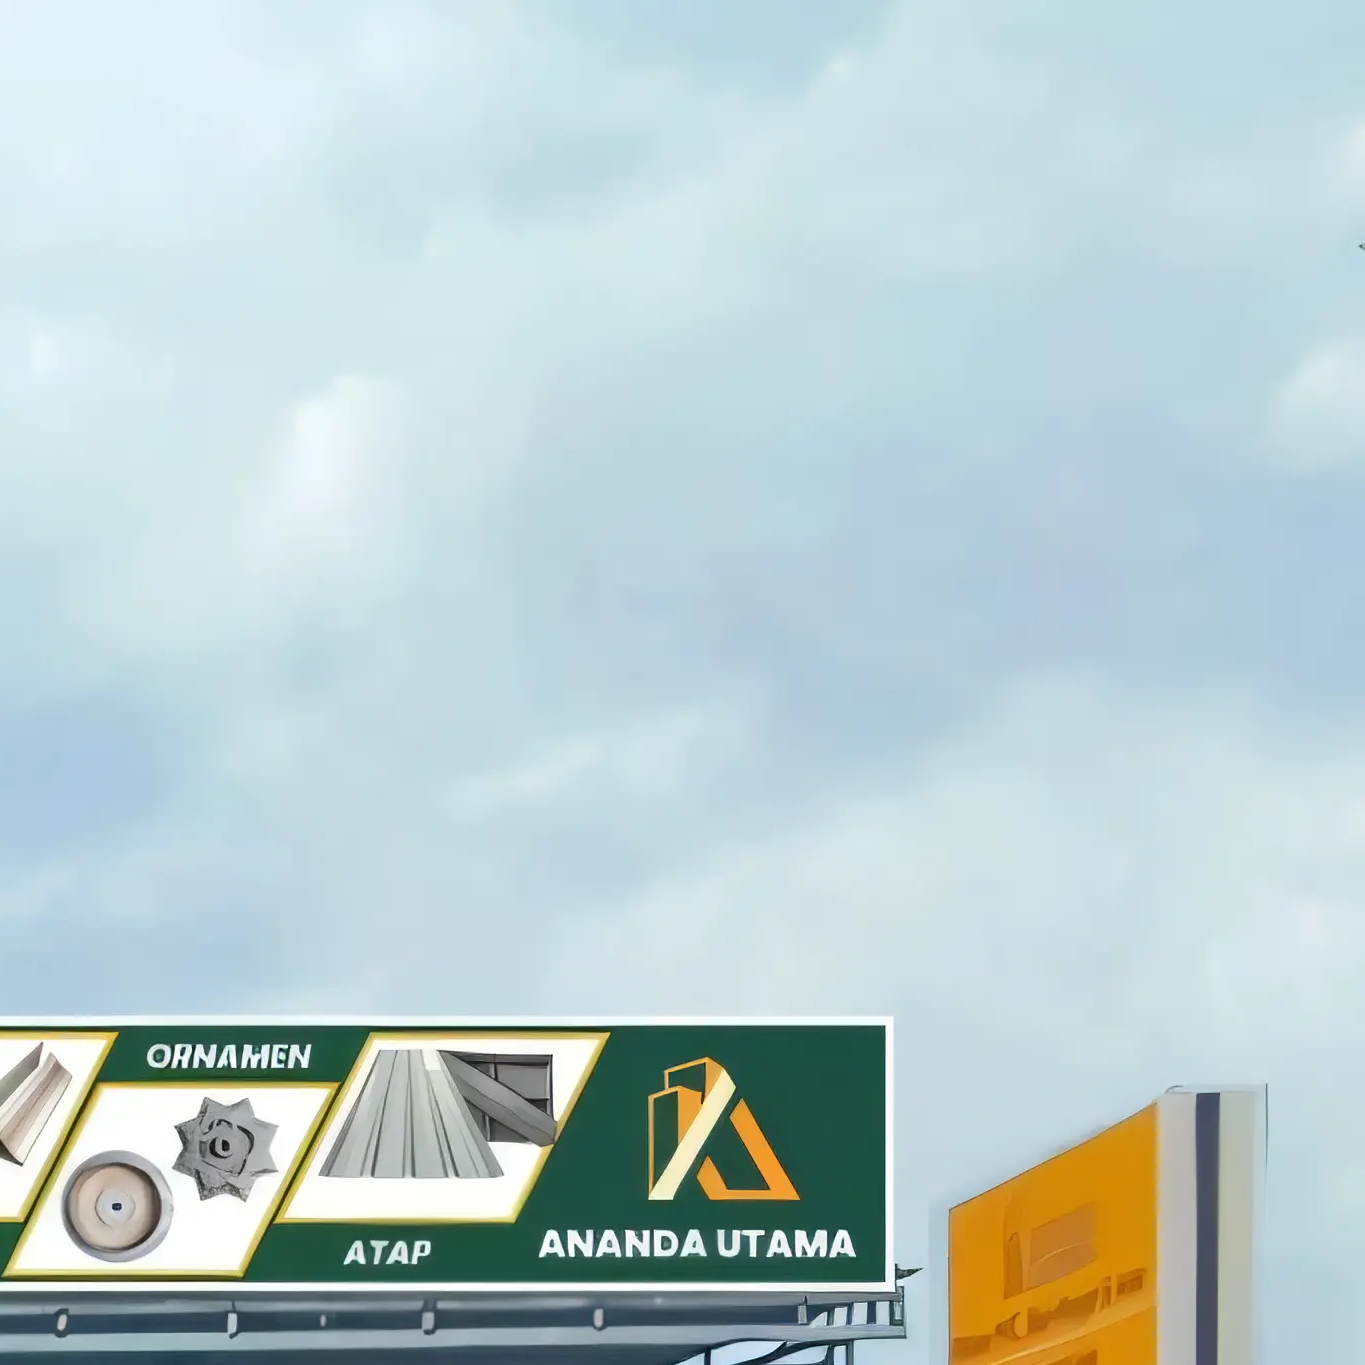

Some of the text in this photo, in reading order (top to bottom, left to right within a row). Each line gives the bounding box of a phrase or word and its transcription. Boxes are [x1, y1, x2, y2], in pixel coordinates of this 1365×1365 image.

[147, 1043, 312, 1070] ORNAMEN
[343, 1240, 432, 1265] ATAP
[538, 1229, 857, 1259] ANANDA UTAMA
